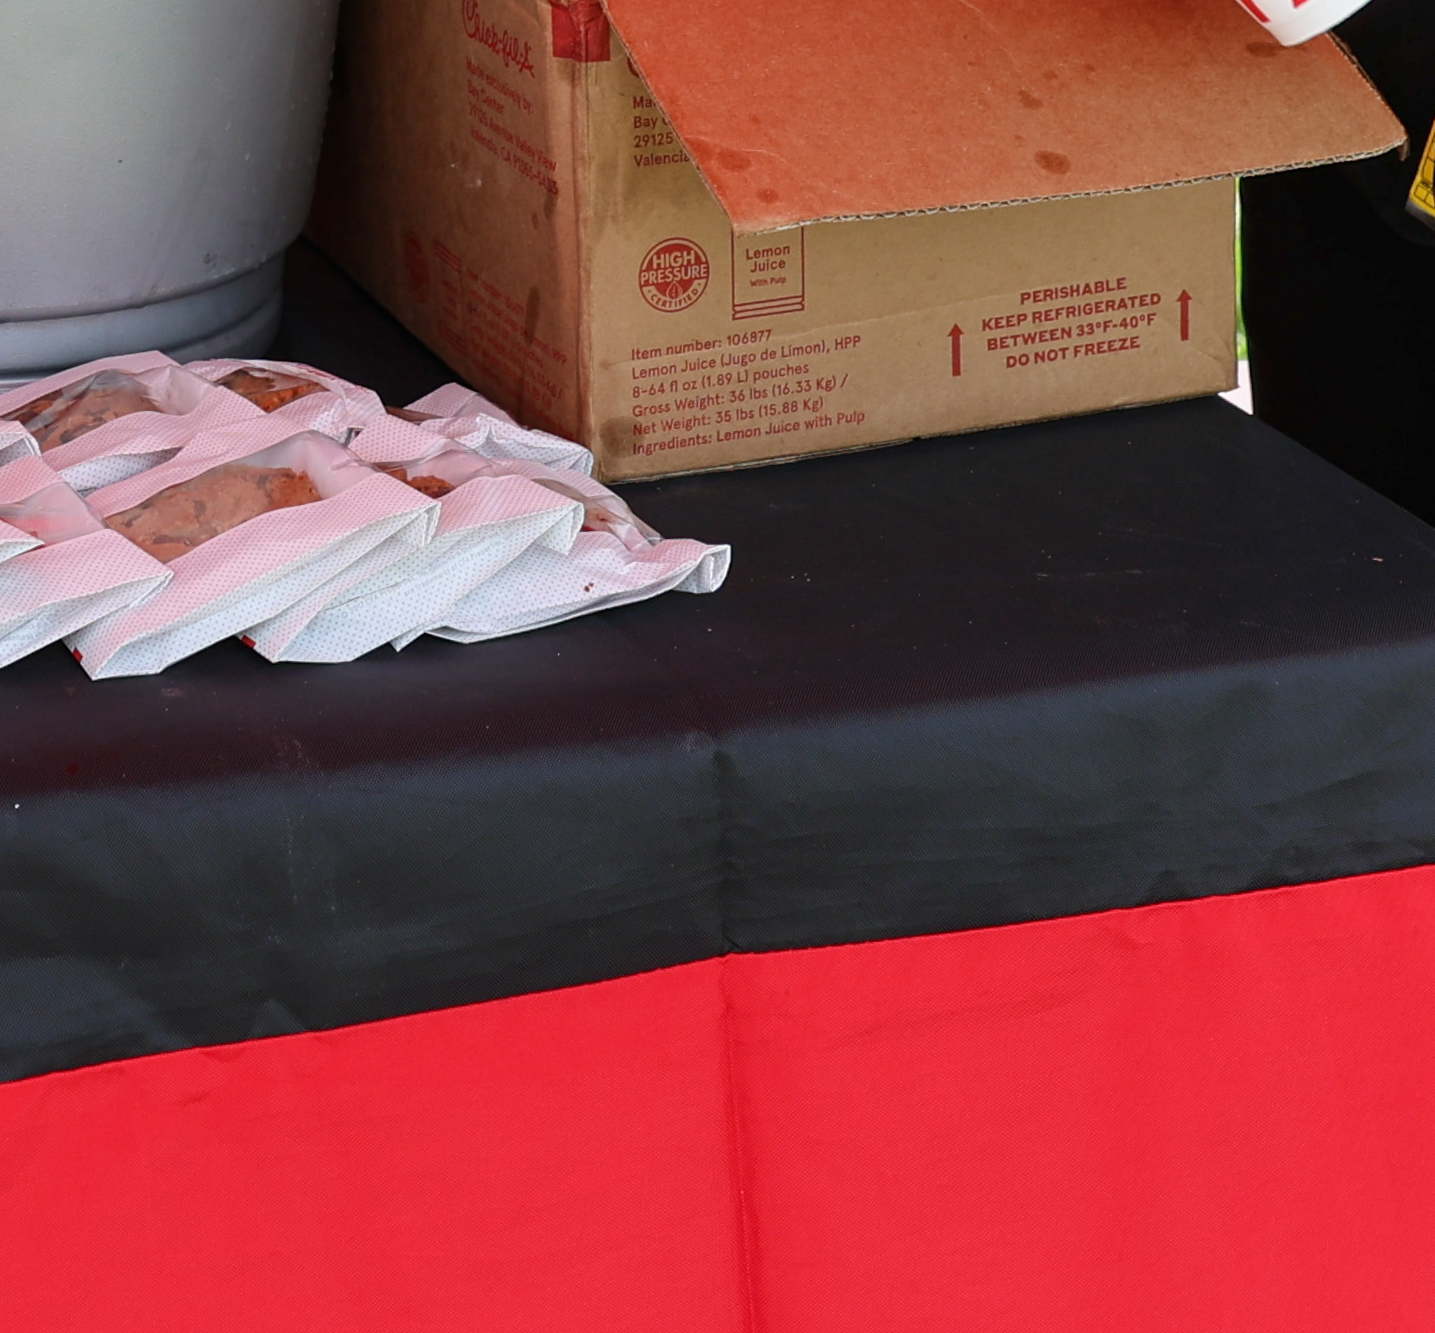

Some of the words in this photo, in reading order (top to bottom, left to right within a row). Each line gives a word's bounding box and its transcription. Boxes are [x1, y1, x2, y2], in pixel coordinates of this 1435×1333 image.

[634, 116, 658, 129] Bay
[634, 134, 674, 148] 29125
[653, 249, 695, 268] HIGH
[745, 245, 790, 260] Lemon
[640, 263, 708, 286] PRESSURE
[750, 259, 786, 274] Juice
[770, 275, 786, 286] Pulp
[1020, 277, 1127, 305] PERISHABLE
[650, 288, 699, 309] CERTIFIED
[982, 313, 1028, 332] KEEP
[1032, 293, 1161, 325] REFRIGERATED
[631, 347, 662, 361] Item
[665, 340, 722, 356] number:
[726, 329, 772, 347] 106877
[987, 326, 1072, 351] BETWEEN
[632, 365, 677, 380] Lemon
[681, 356, 716, 374] Juice
[720, 353, 756, 369] (Jugo
[760, 349, 776, 361] de
[835, 335, 861, 350] HPP
[1006, 354, 1029, 369] DO
[1034, 347, 1070, 364] NOT
[1074, 336, 1140, 358] FREEZE
[632, 383, 665, 399] 8-64
[670, 380, 678, 393] fl
[683, 379, 697, 391] oz
[701, 372, 732, 389] (1.89
[737, 368, 749, 384] L)
[753, 363, 809, 383] pouches
[632, 402, 671, 418] Gross
[674, 392, 725, 413] Weight:
[729, 389, 745, 403] 36
[750, 385, 768, 400] lbs
[772, 380, 811, 398] (16.33
[816, 375, 836, 392] Kg)
[634, 422, 657, 437] Net
[661, 414, 711, 433] Weight:
[715, 410, 731, 423] 35
[736, 407, 755, 421] lbs
[758, 402, 798, 419] (15.88
[803, 396, 823, 413] Kg)
[632, 434, 712, 456] Ingredients:
[717, 426, 761, 443] Lemon
[765, 419, 800, 436] Juice
[804, 415, 832, 430] with
[836, 409, 865, 426] Pulp
